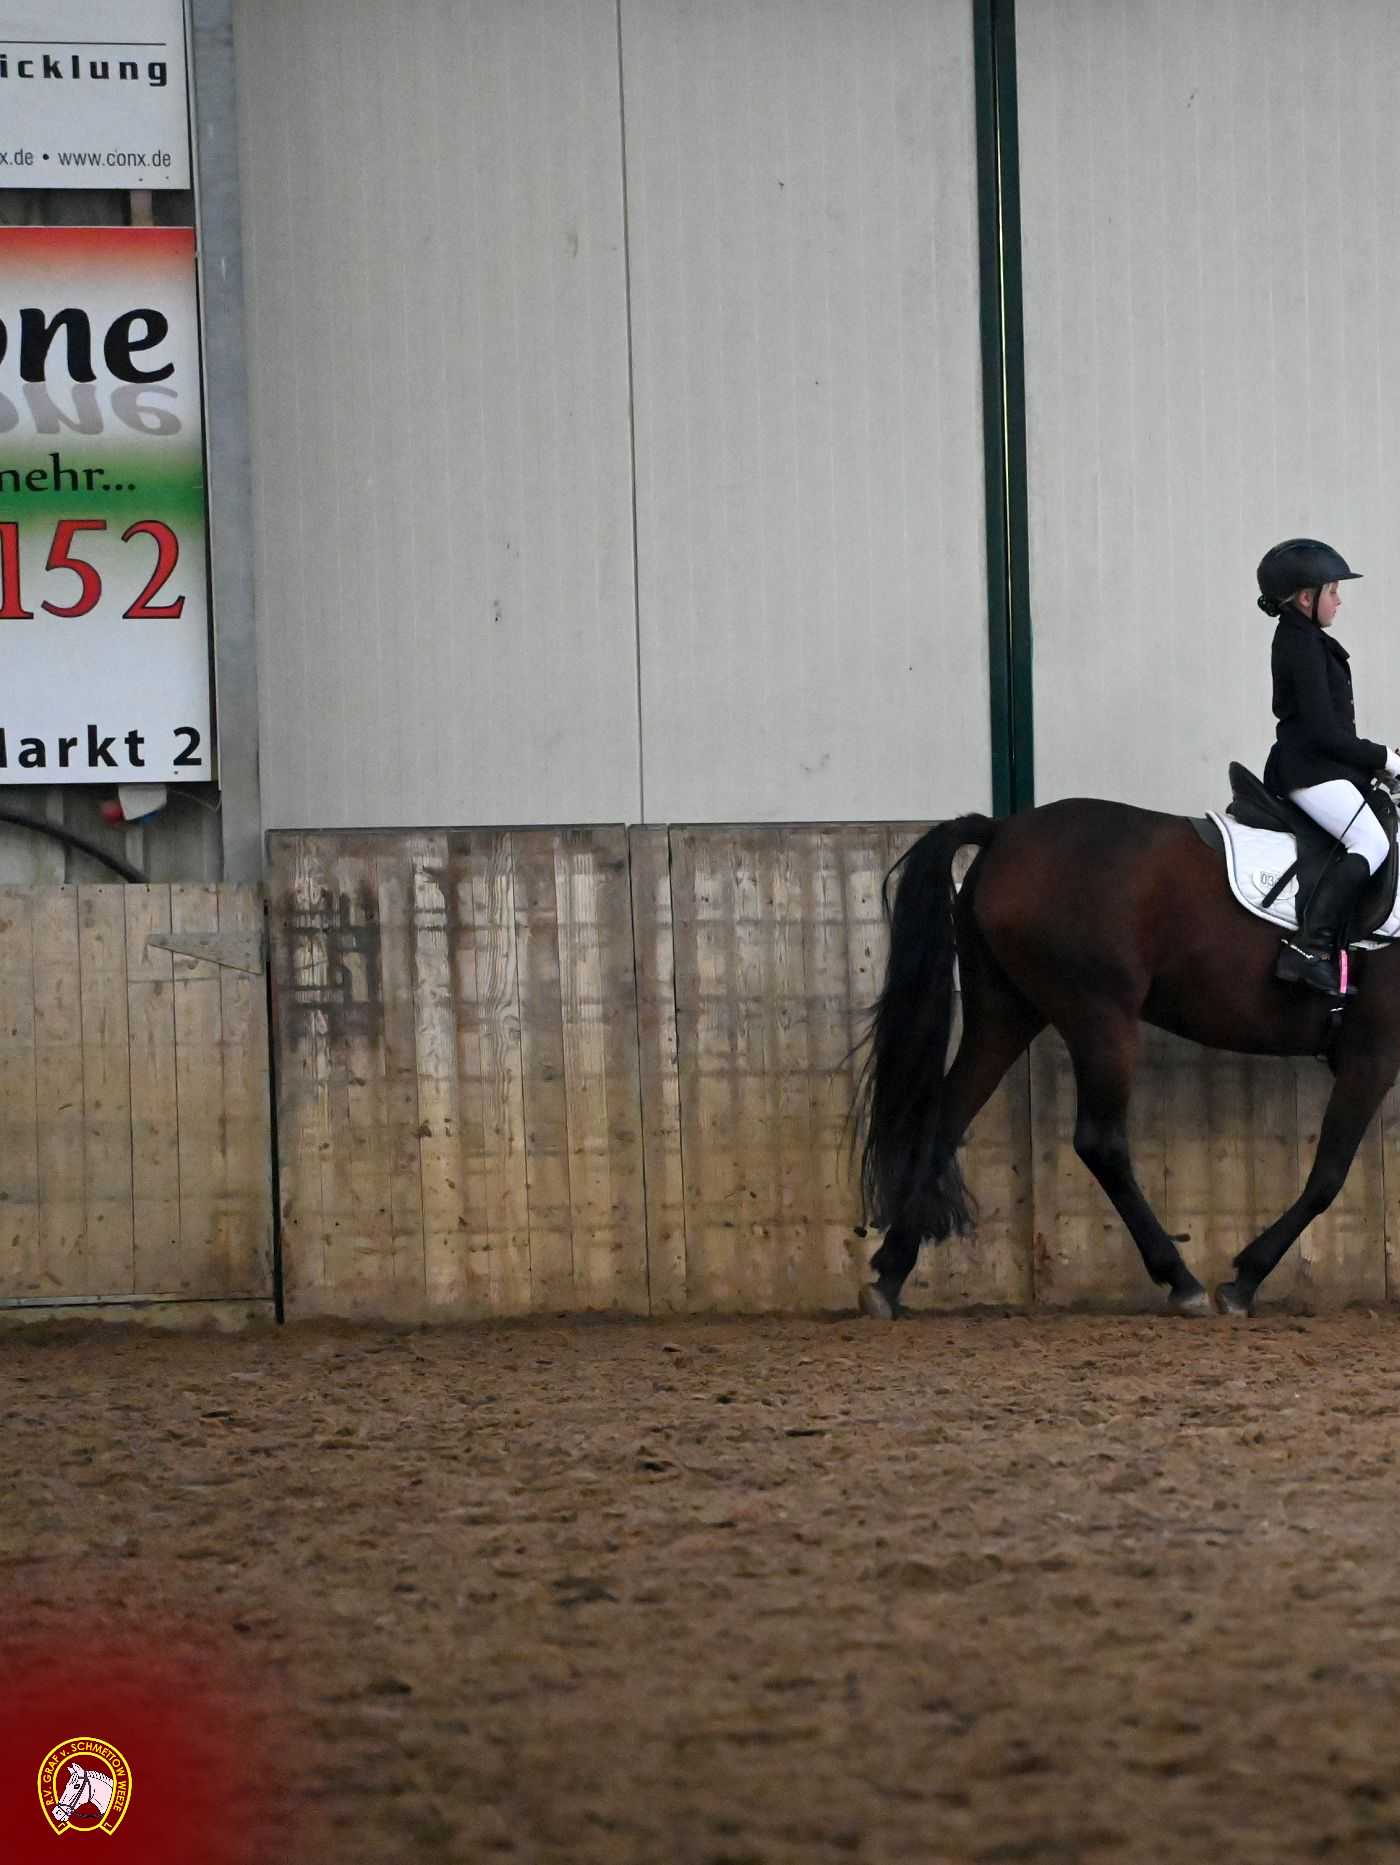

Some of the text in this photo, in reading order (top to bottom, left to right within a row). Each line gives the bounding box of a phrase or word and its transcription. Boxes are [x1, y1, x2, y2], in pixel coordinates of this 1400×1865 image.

[58, 150, 171, 168] www.conx.de
[0, 308, 175, 383] ne
[0, 725, 202, 768] arkt 2
